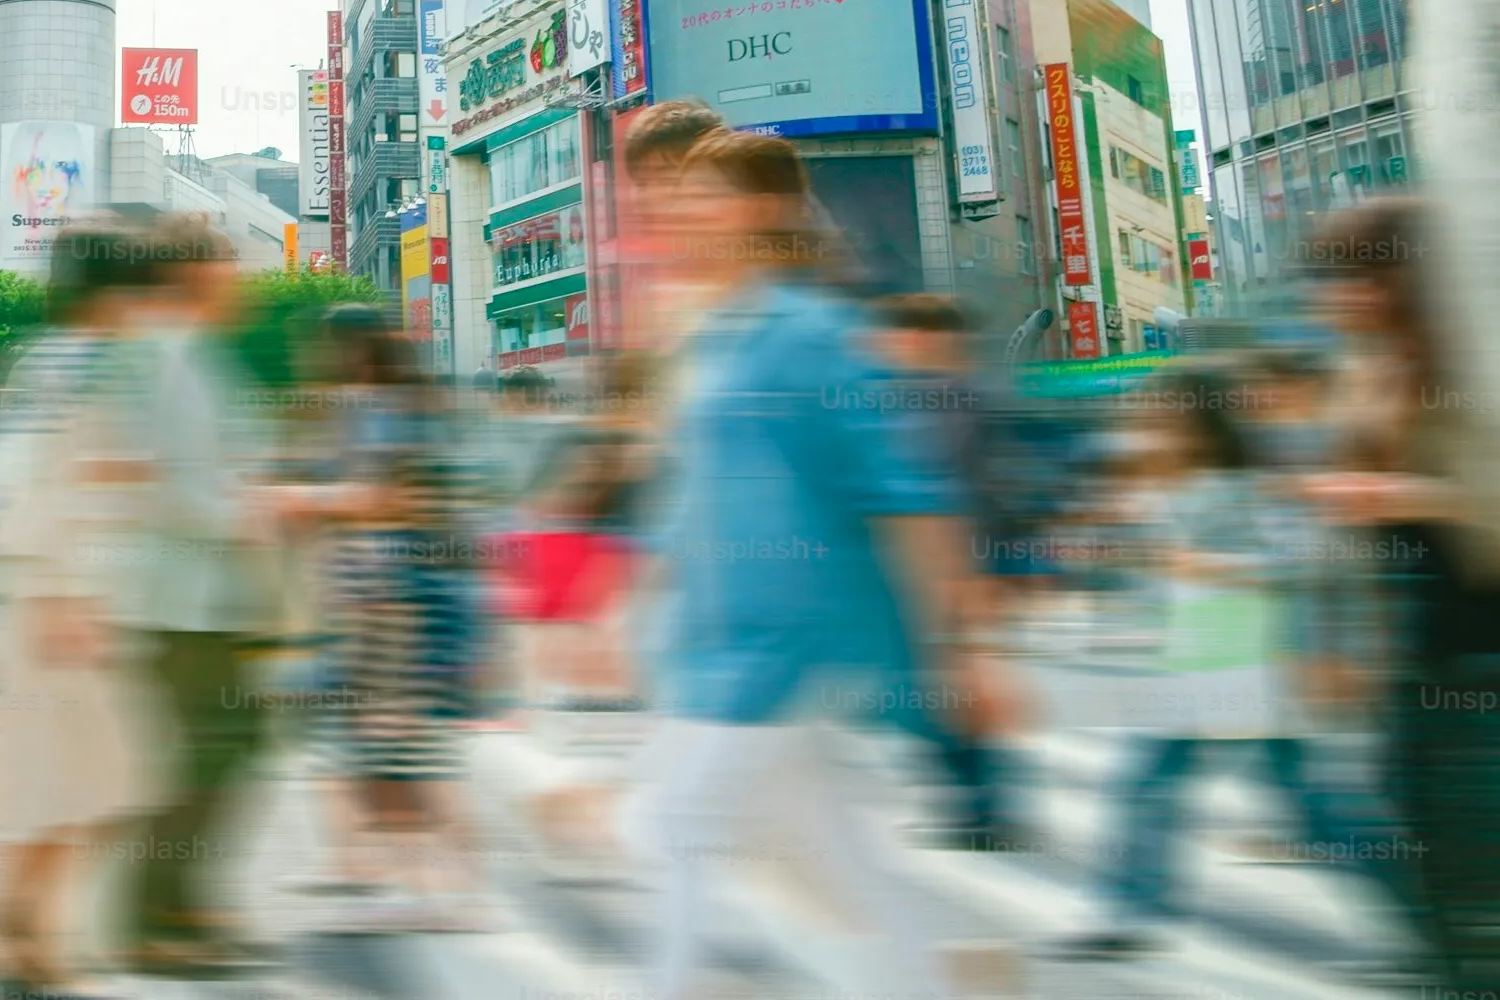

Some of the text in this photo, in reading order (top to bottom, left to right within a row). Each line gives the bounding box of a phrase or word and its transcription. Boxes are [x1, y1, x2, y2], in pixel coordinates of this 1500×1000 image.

[727, 31, 793, 62] DHC
[136, 55, 184, 88] H&M
[947, 15, 976, 110] neon
[153, 95, 180, 105] この先
[153, 104, 189, 117] 150m
[754, 124, 781, 137] DHC
[1050, 69, 1075, 189] クスリのことなら
[308, 106, 330, 210] Essential
[962, 145, 984, 155] (03)
[962, 155, 987, 166] 3719
[963, 165, 989, 177] 2468
[1060, 198, 1088, 275] 三千里
